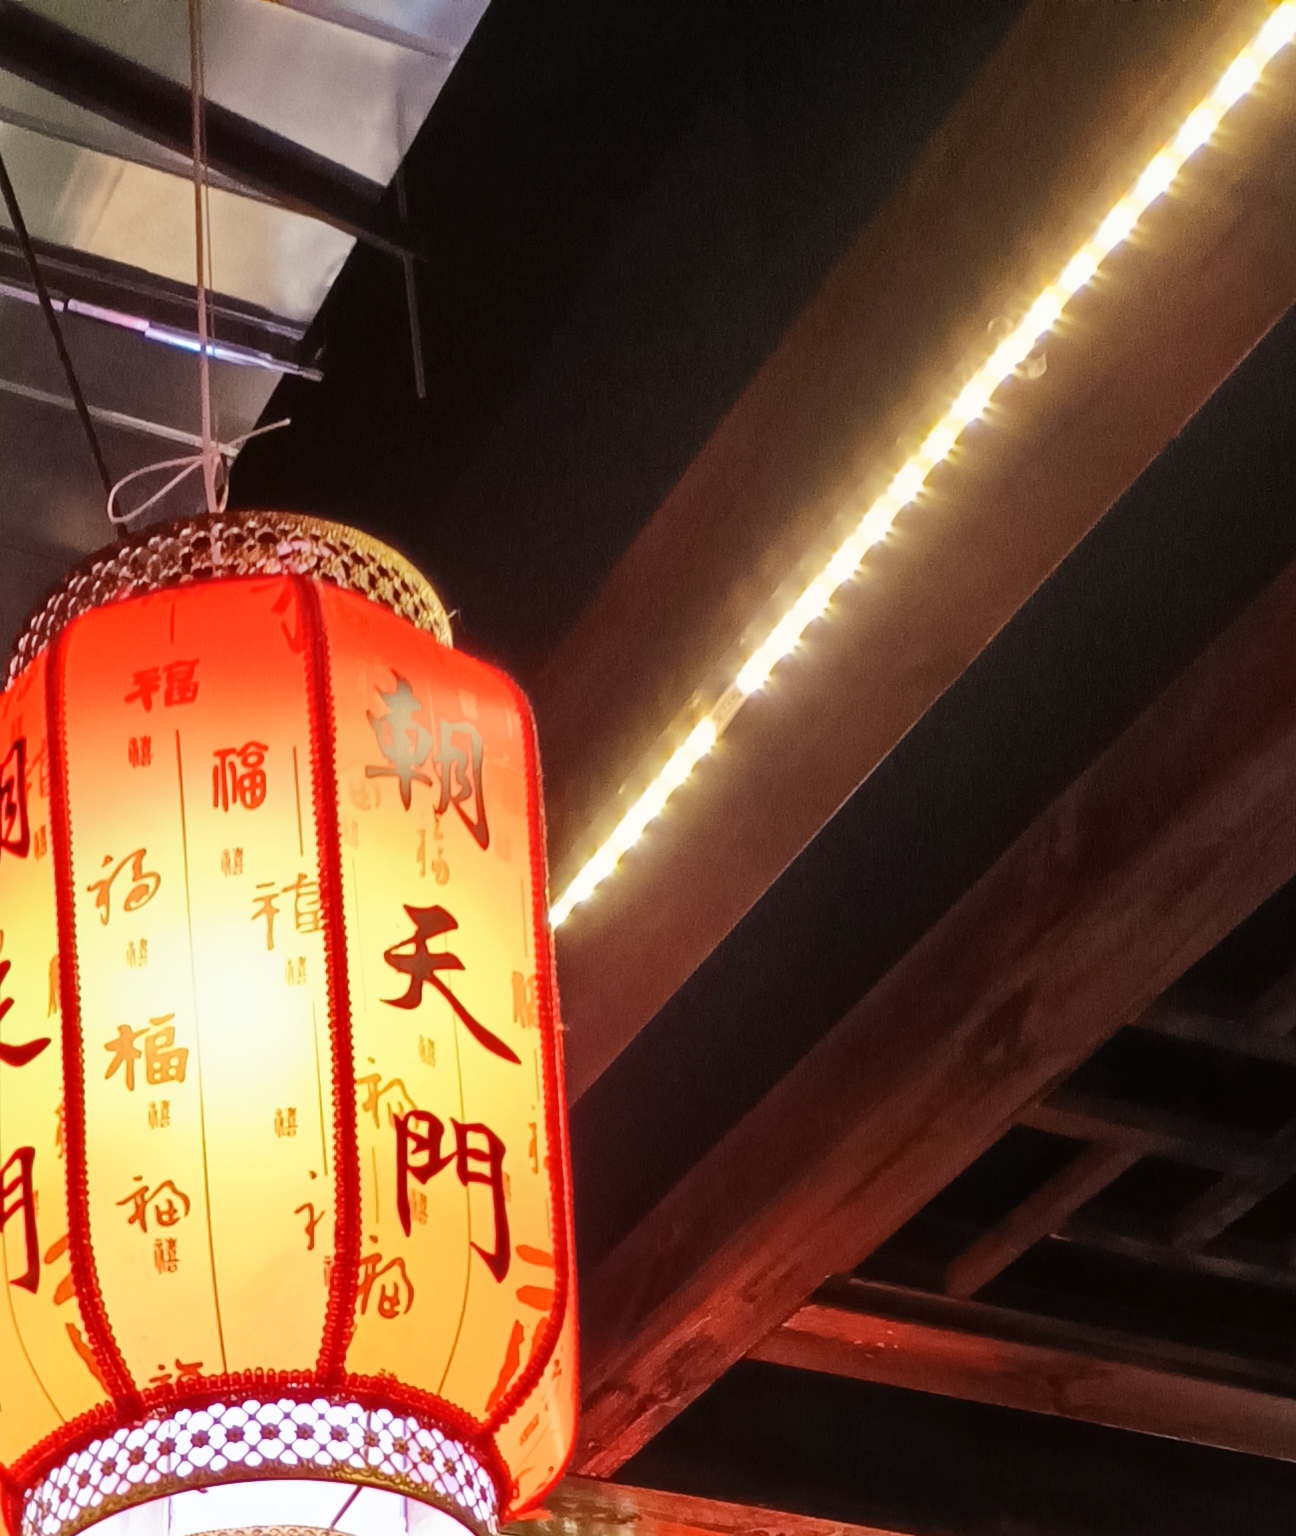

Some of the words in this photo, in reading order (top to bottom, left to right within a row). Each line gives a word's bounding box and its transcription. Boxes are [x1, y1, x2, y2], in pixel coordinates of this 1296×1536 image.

[211, 740, 269, 813] 福
[365, 666, 522, 1283] 朝天門
[104, 1013, 189, 1092] 福
